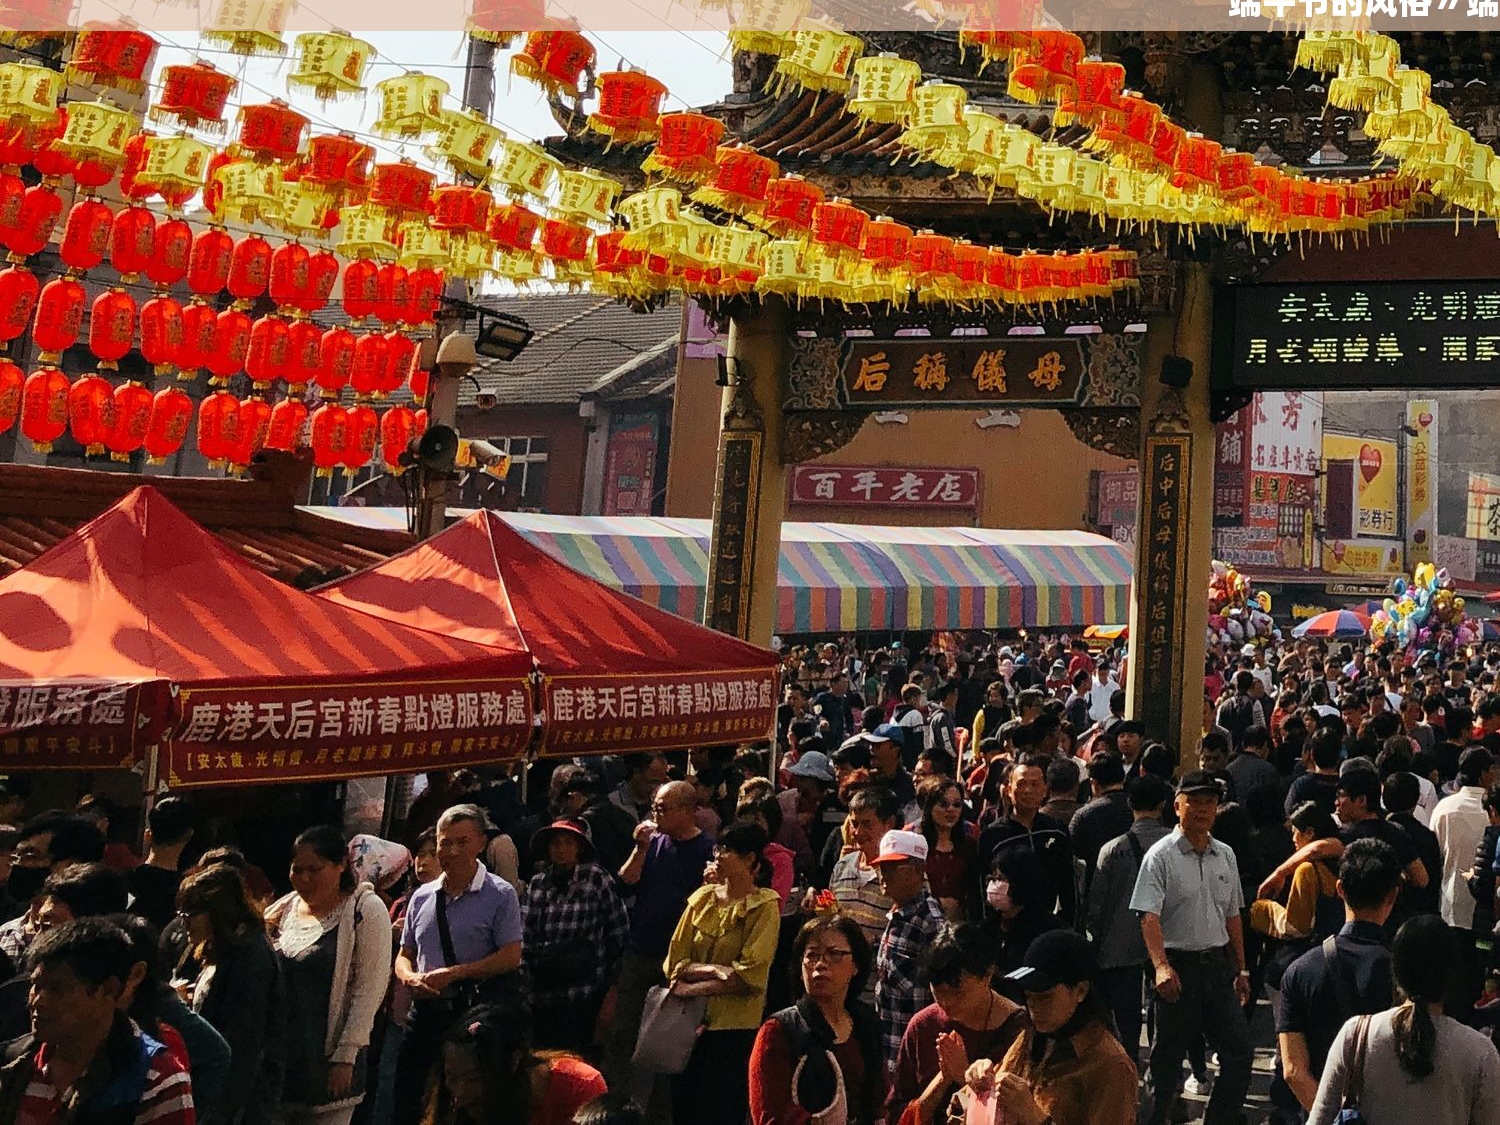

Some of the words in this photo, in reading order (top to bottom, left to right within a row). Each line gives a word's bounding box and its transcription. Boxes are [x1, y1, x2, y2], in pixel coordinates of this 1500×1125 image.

[852, 348, 1066, 395] 母儀稱后
[808, 470, 963, 503] 百年老店
[1359, 508, 1394, 531] 彩券行
[178, 688, 527, 743] 鹿港天后宮新春點燈服務處
[552, 678, 773, 722] 鹿港天后宮新春點燈服務處
